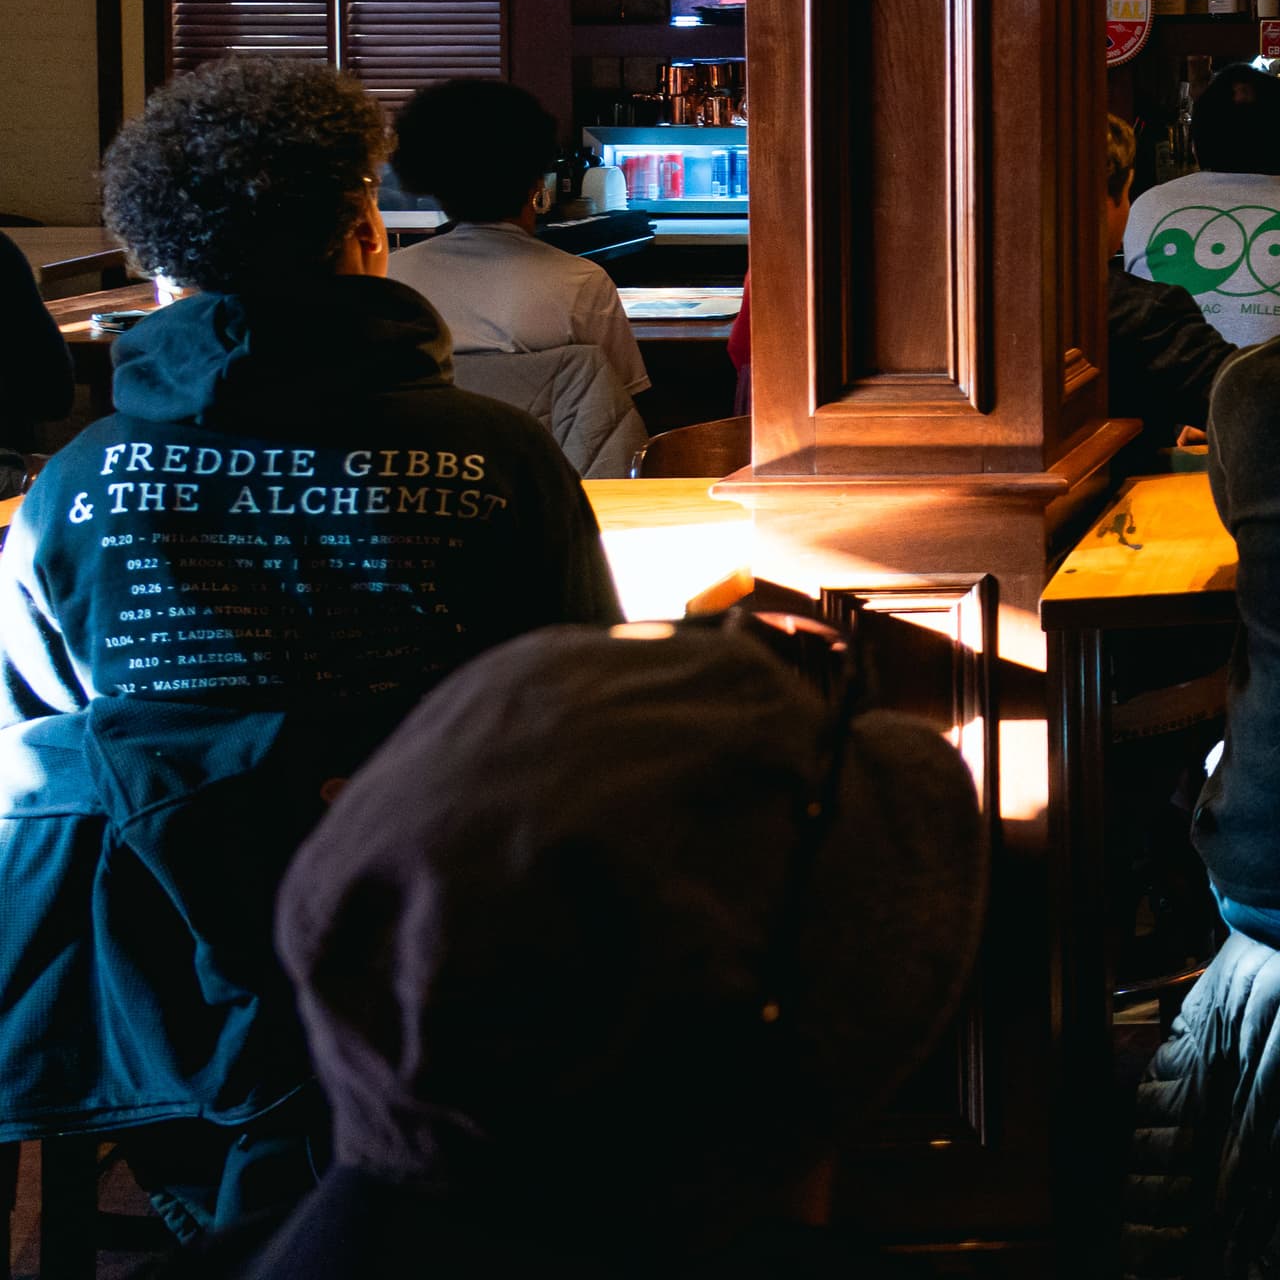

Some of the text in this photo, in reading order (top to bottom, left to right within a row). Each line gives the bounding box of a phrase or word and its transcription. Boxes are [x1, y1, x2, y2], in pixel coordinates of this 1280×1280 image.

[1200, 303, 1222, 314] AC
[100, 442, 486, 481] FREDDIE GIBBS
[68, 483, 507, 524] & THE ALCHEMIST
[273, 535, 292, 545] PA
[320, 535, 352, 545] 09.21
[126, 558, 159, 570] 09.22
[131, 583, 162, 595] 09.26
[120, 607, 151, 621] 09.28
[168, 606, 196, 617] SAN
[151, 632, 172, 643] FT.
